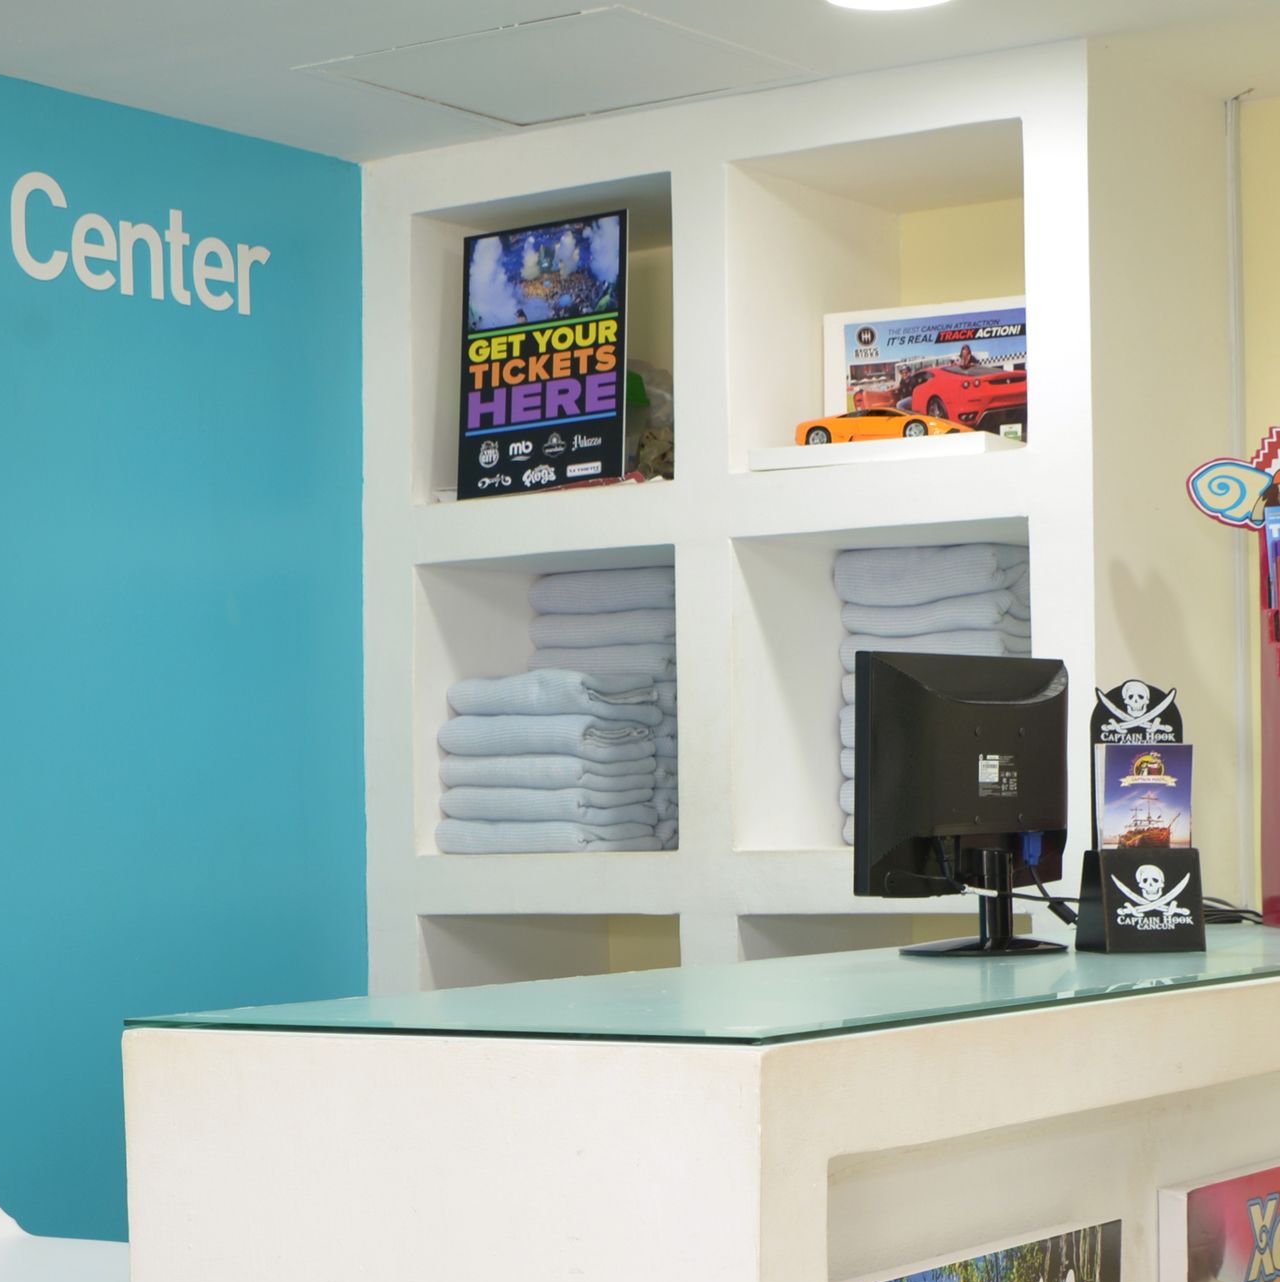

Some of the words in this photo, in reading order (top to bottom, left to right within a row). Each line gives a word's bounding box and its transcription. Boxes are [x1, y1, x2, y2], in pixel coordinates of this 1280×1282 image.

[10, 171, 271, 315] Center
[468, 333, 526, 364] GET
[532, 319, 618, 353] YOUR
[886, 336, 906, 347] IT'S
[907, 334, 934, 345] REAL
[939, 329, 974, 342] TRACK
[974, 324, 1022, 339] ACTION!
[902, 326, 920, 334] BEST
[951, 319, 1001, 330] ATTRACTION
[469, 344, 617, 390] TICKETS
[467, 371, 617, 430] HERE
[1100, 732, 1143, 742] CAPTAIN
[1146, 731, 1176, 742] HOOK
[1116, 916, 1160, 926] CAPTAIN
[1162, 915, 1194, 925] HOOK
